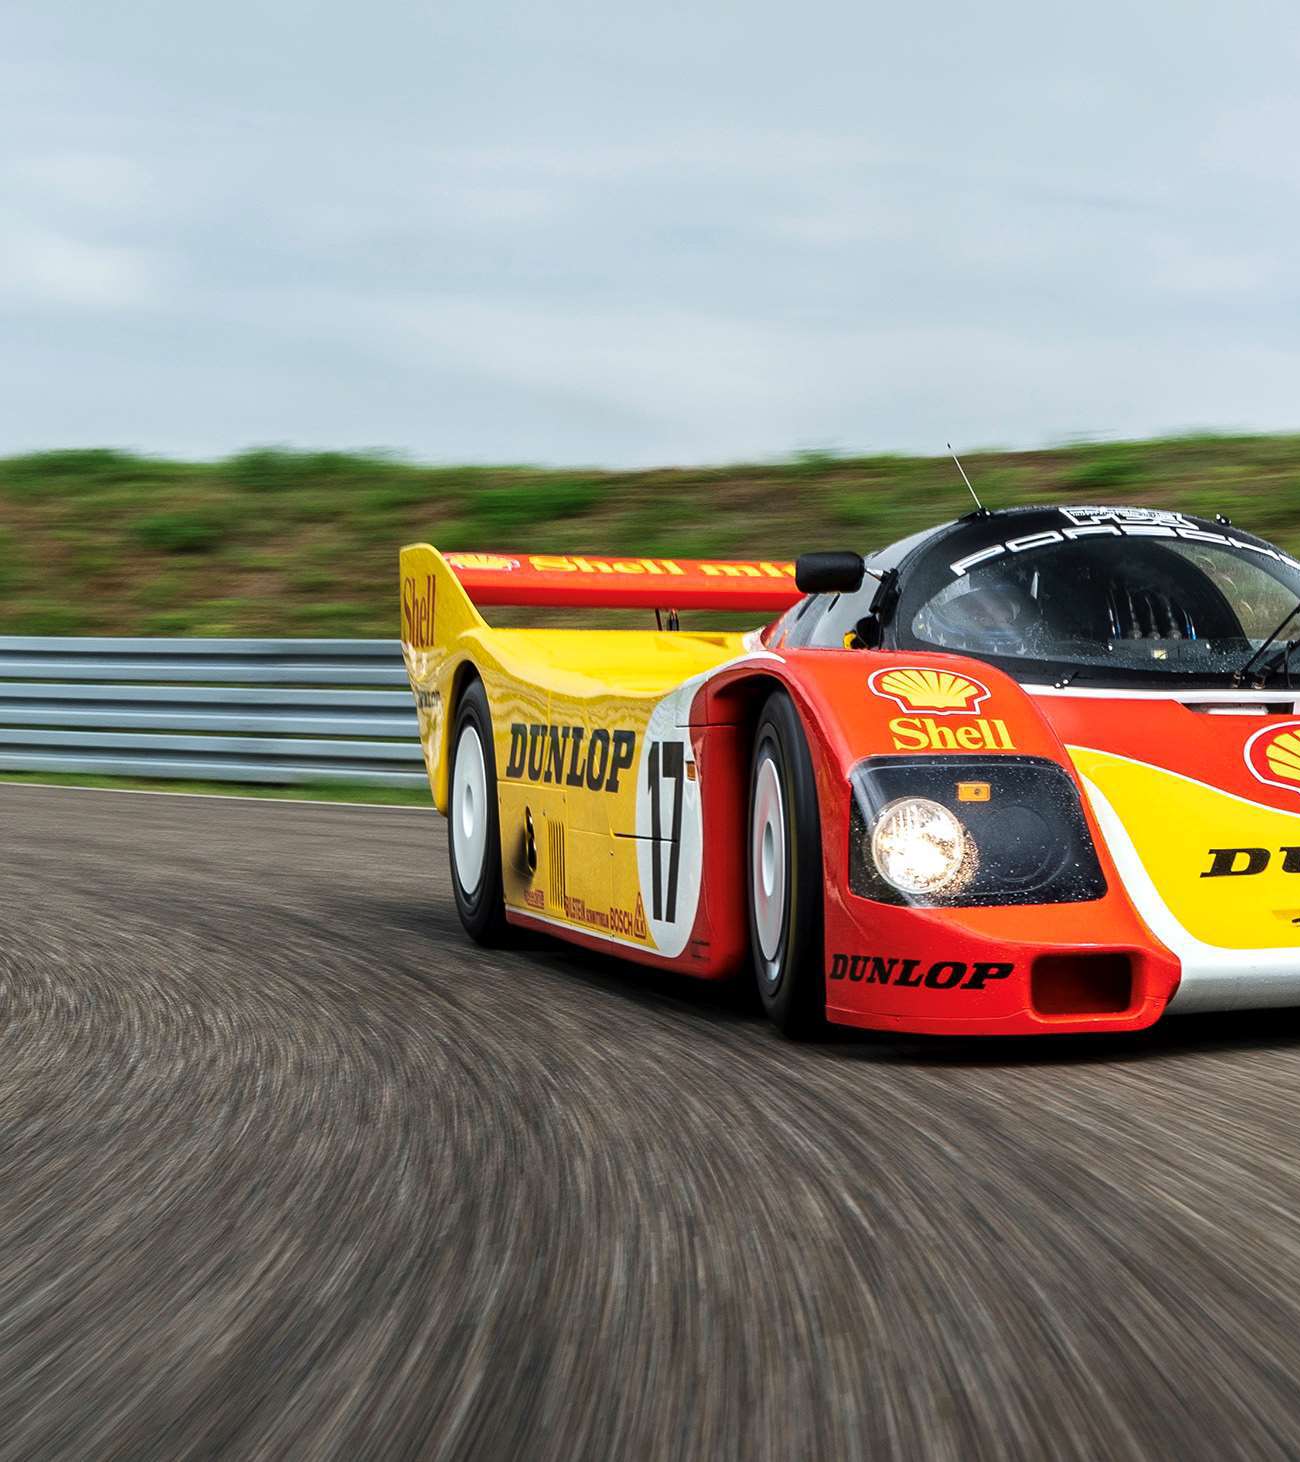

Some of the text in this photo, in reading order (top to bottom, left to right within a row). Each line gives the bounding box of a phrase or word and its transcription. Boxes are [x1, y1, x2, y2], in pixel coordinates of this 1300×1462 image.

[528, 555, 685, 575] Shell
[403, 575, 436, 648] Shell
[888, 717, 1017, 751] Shell
[506, 723, 636, 793] DUNLOP
[647, 741, 684, 923] 17
[609, 907, 633, 937] BOSCH
[830, 953, 1015, 990] DUNLOP
